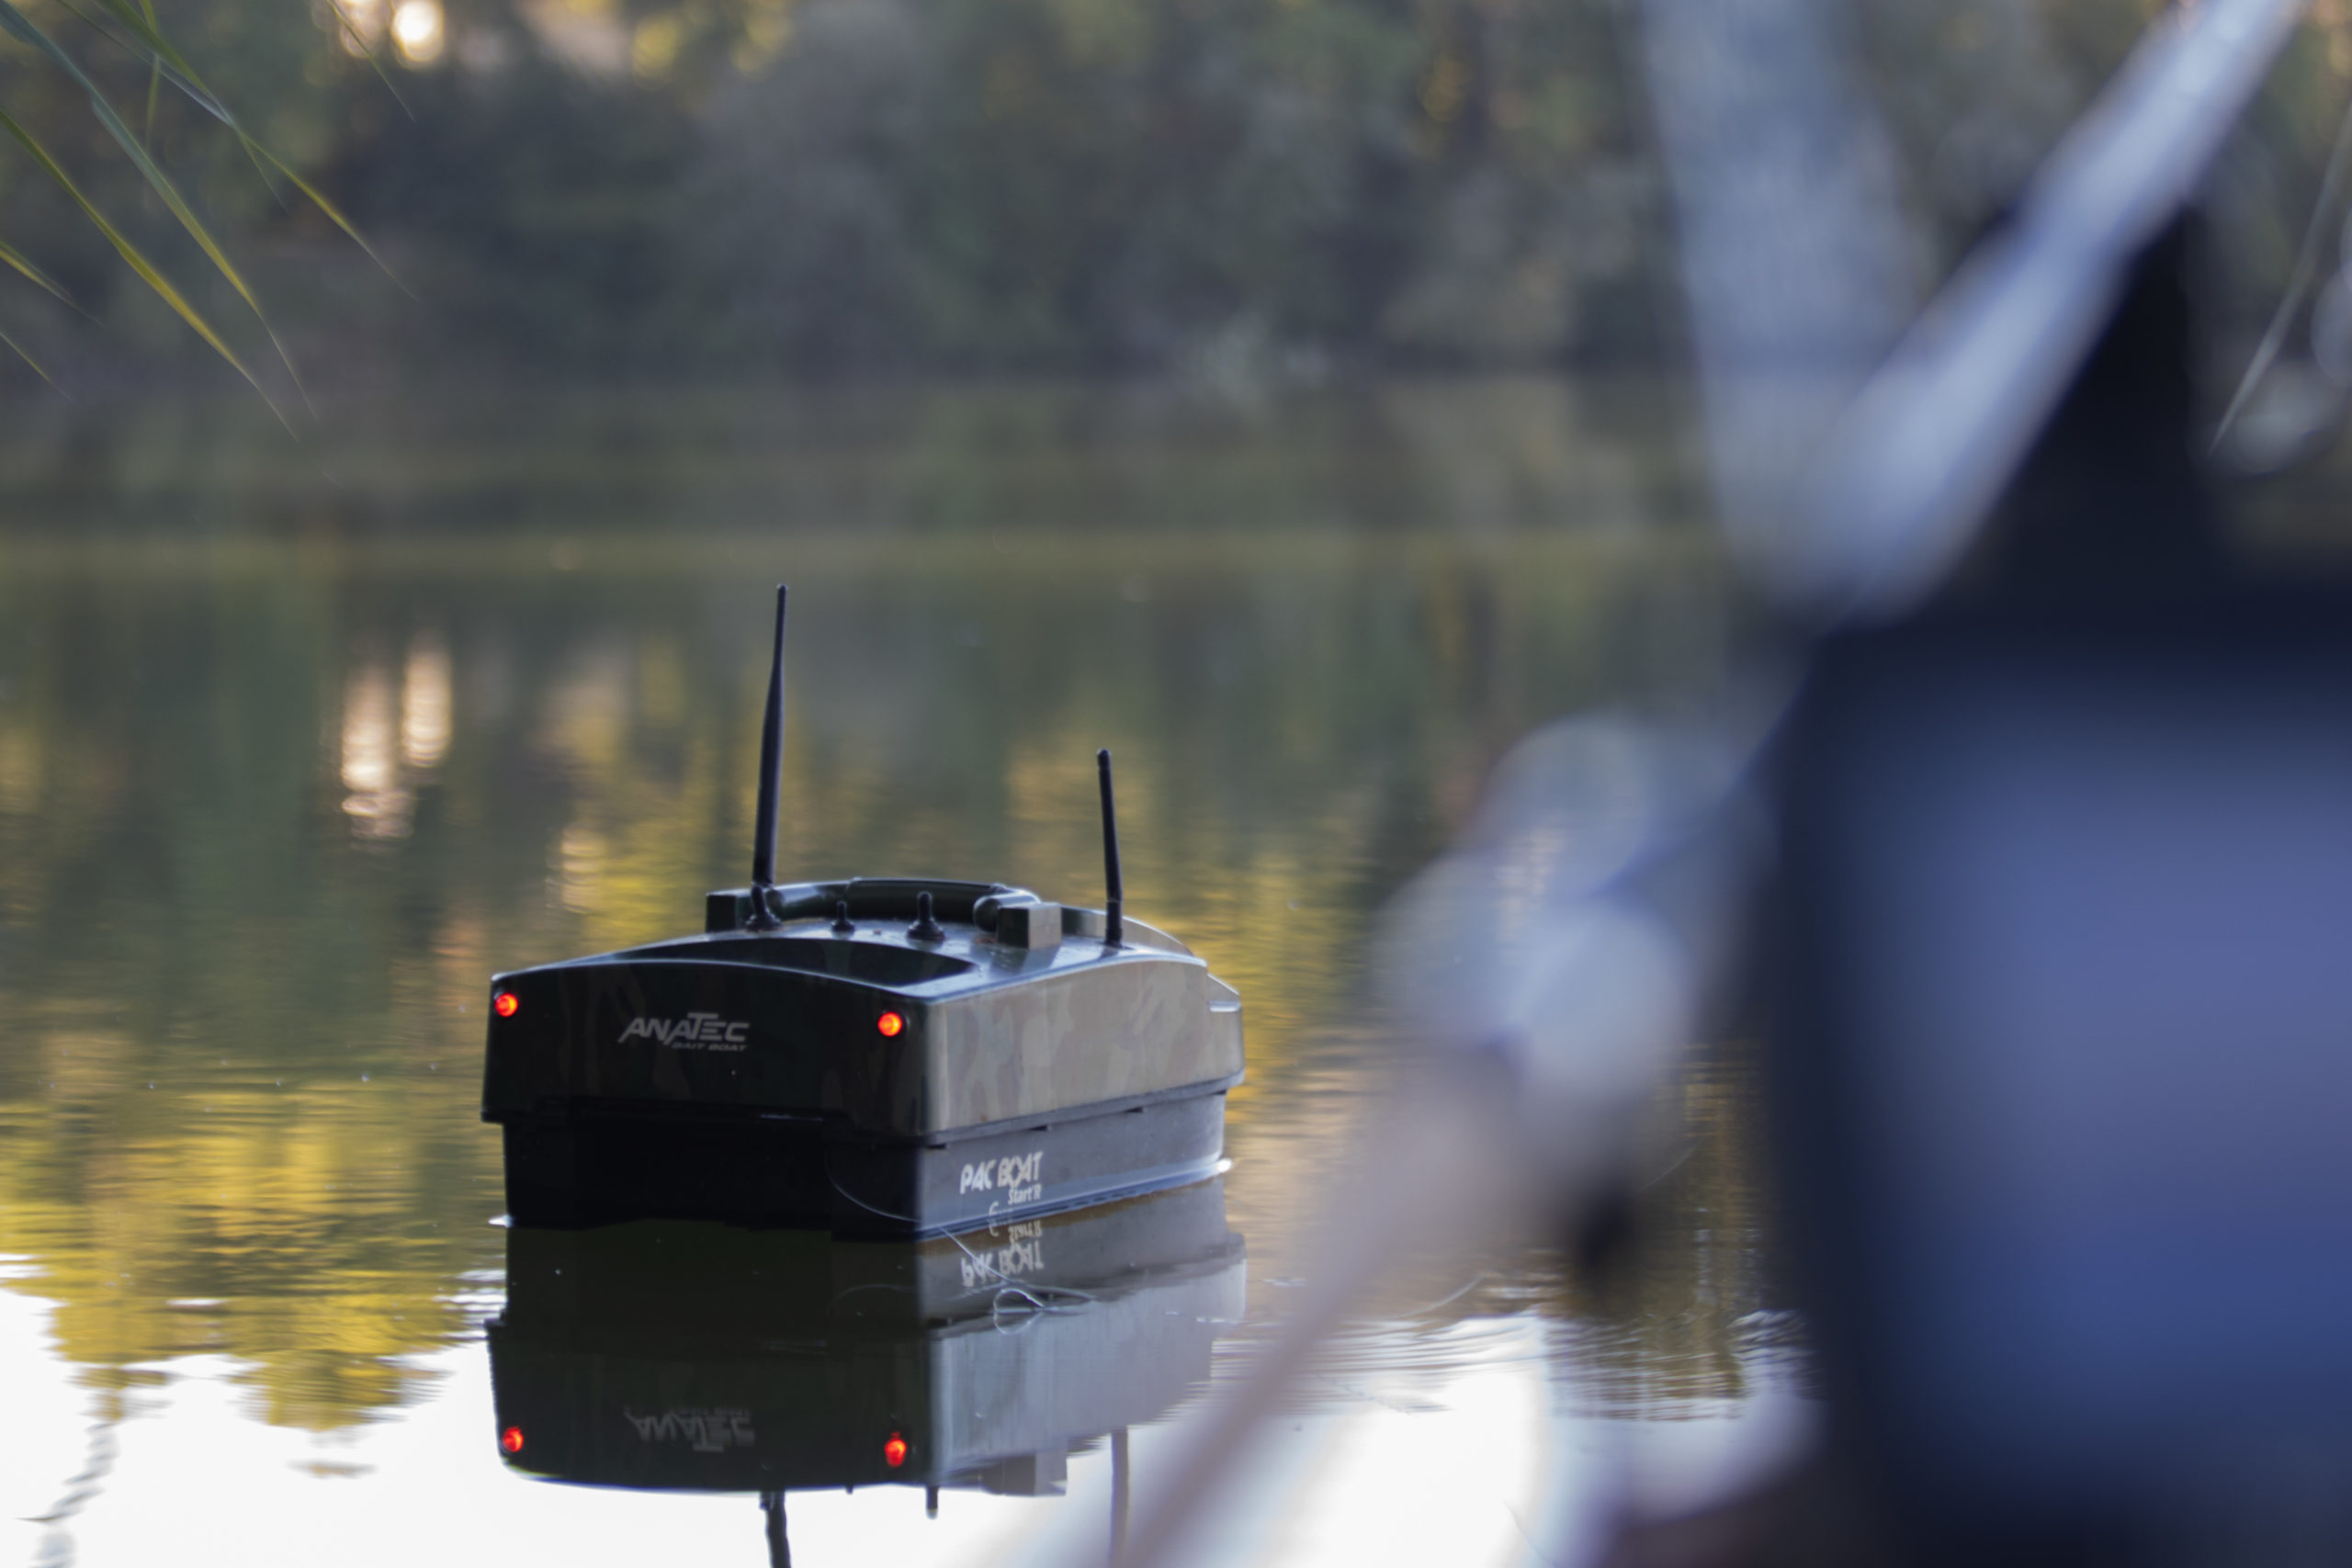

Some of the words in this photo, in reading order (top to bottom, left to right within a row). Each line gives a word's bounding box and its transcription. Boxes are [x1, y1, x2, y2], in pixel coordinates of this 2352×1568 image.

[617, 1012, 750, 1045] ANATEC
[671, 1042, 707, 1050] BAIT
[707, 1043, 748, 1052] BOAT
[997, 1151, 1044, 1189] BOAT
